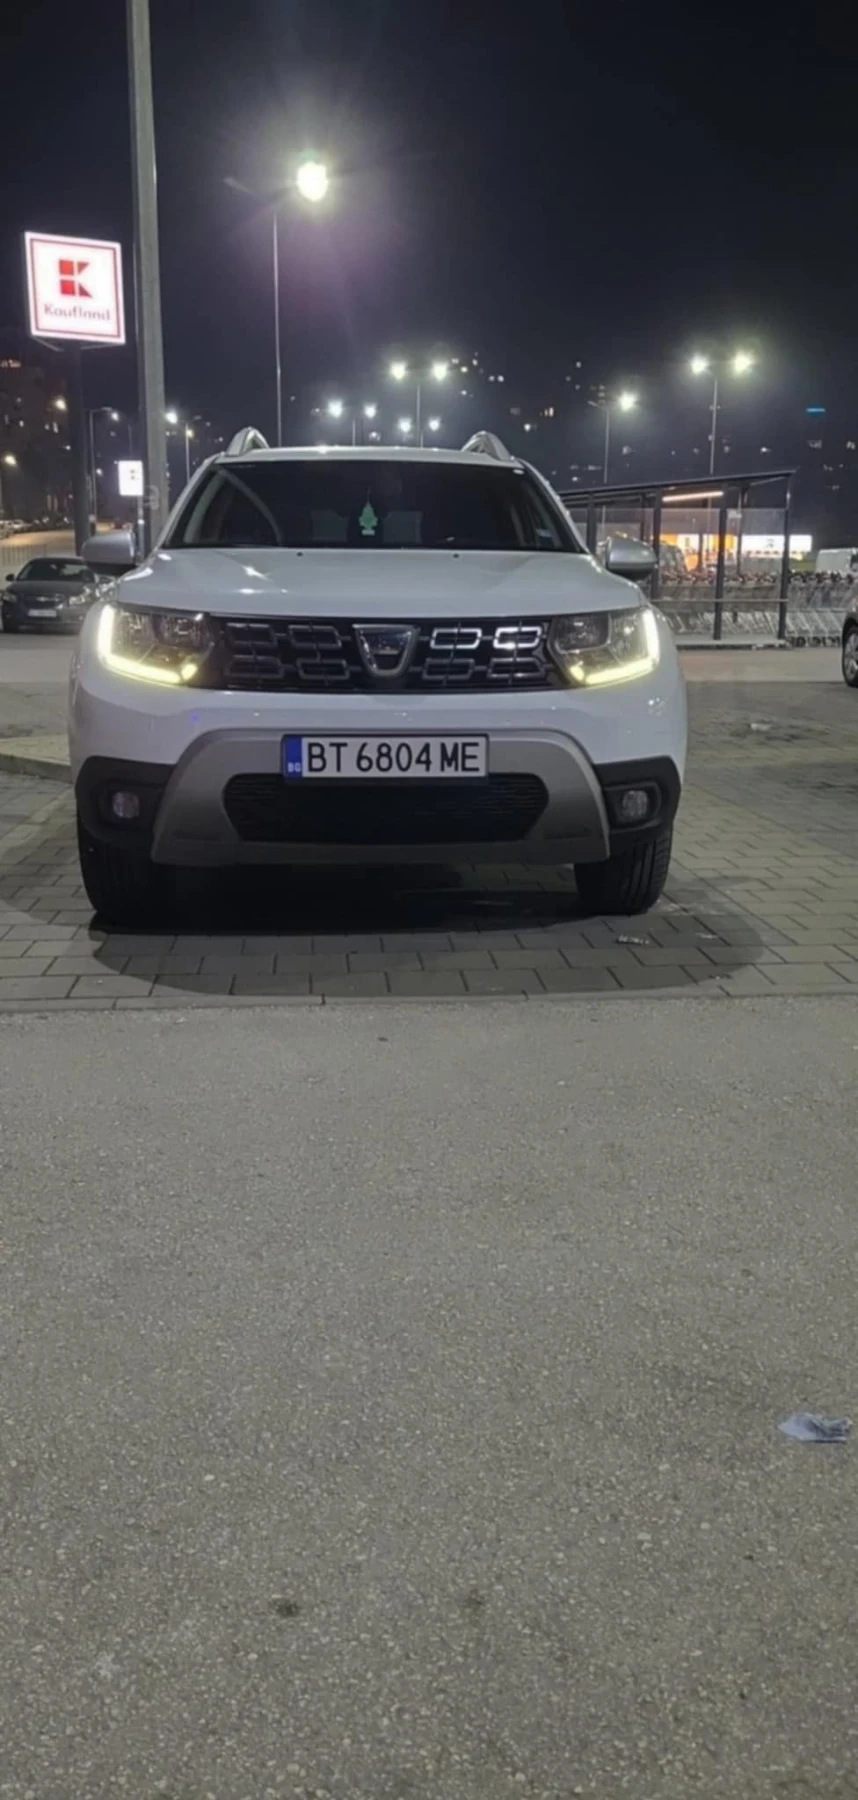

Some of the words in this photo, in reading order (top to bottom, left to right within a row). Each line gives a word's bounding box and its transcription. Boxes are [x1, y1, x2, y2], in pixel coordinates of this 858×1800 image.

[44, 304, 110, 321] Kaufland
[307, 742, 348, 773] BT
[356, 742, 432, 773] 6804
[440, 742, 480, 773] ME
[287, 762, 302, 773] BG
